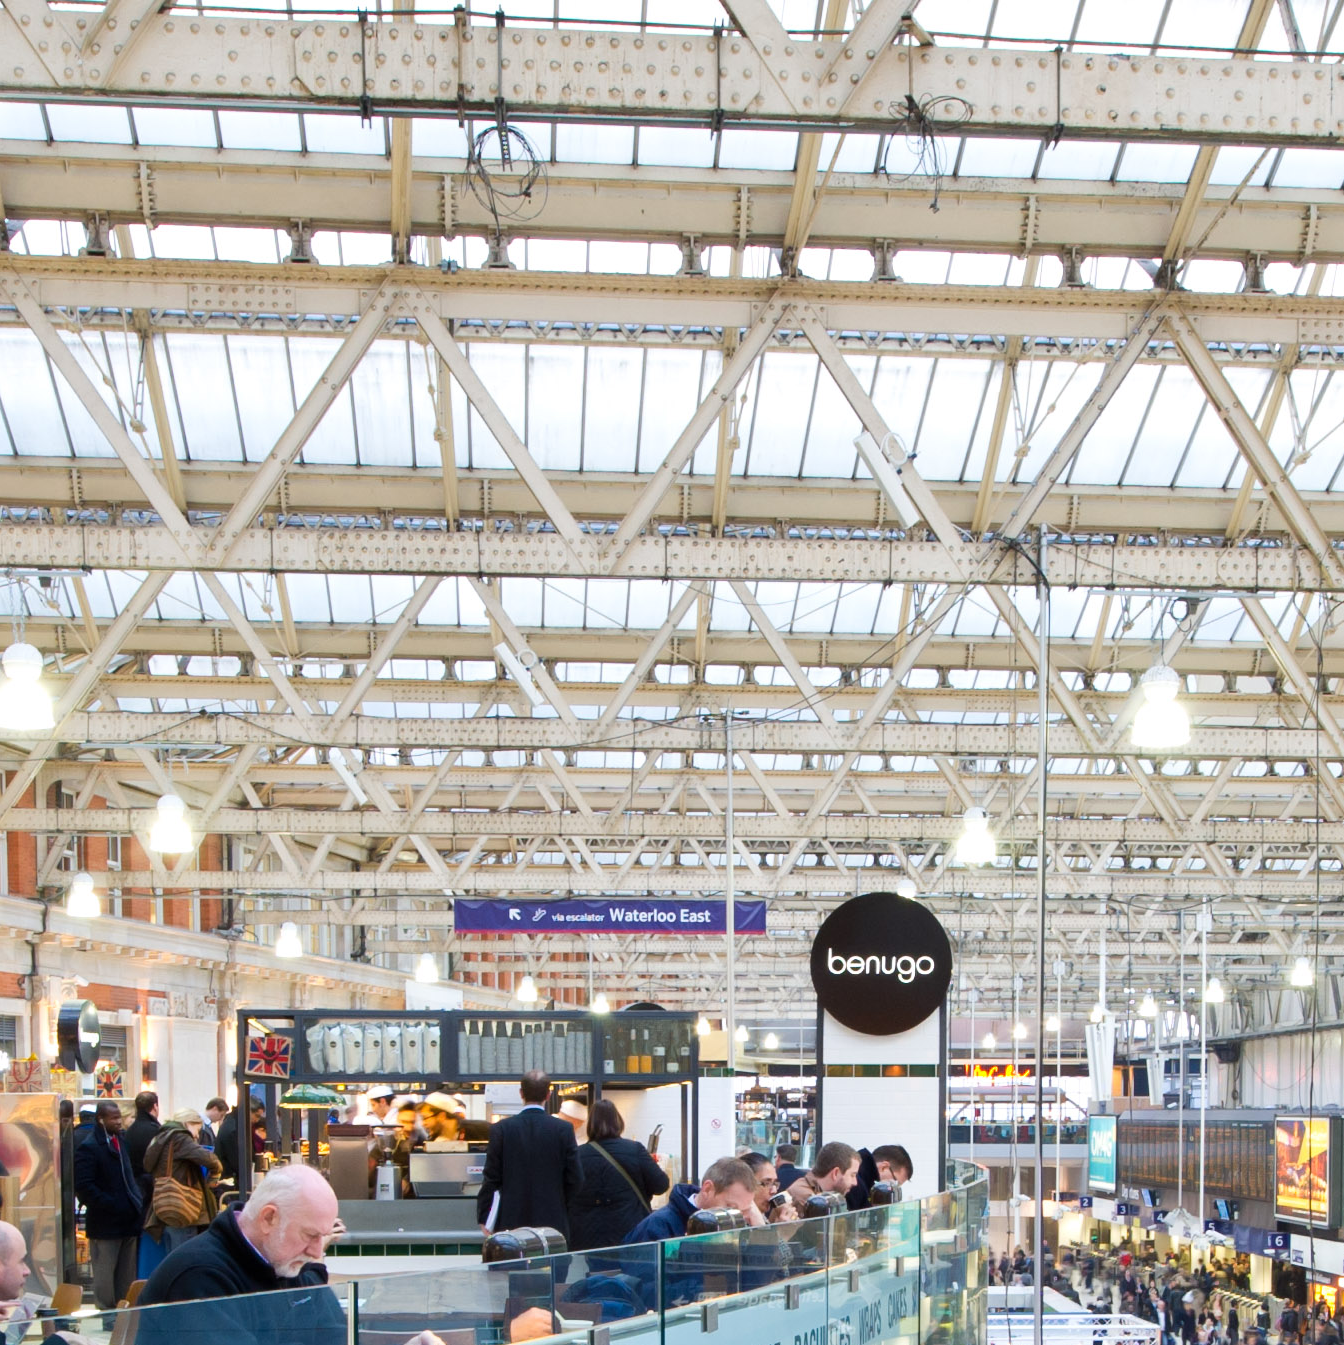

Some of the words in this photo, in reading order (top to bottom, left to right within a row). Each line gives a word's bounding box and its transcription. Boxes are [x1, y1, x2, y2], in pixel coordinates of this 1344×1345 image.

[566, 913, 604, 922] escalator
[609, 908, 677, 923] Waterloo
[680, 909, 711, 923] East
[828, 947, 935, 983] benugo
[1082, 1198, 1089, 1207] 2
[1120, 1205, 1126, 1214] 3
[1208, 1222, 1215, 1232] 5
[1275, 1236, 1283, 1246] 6
[858, 1299, 882, 1345] WRAPS
[888, 1286, 908, 1329] CAKES
